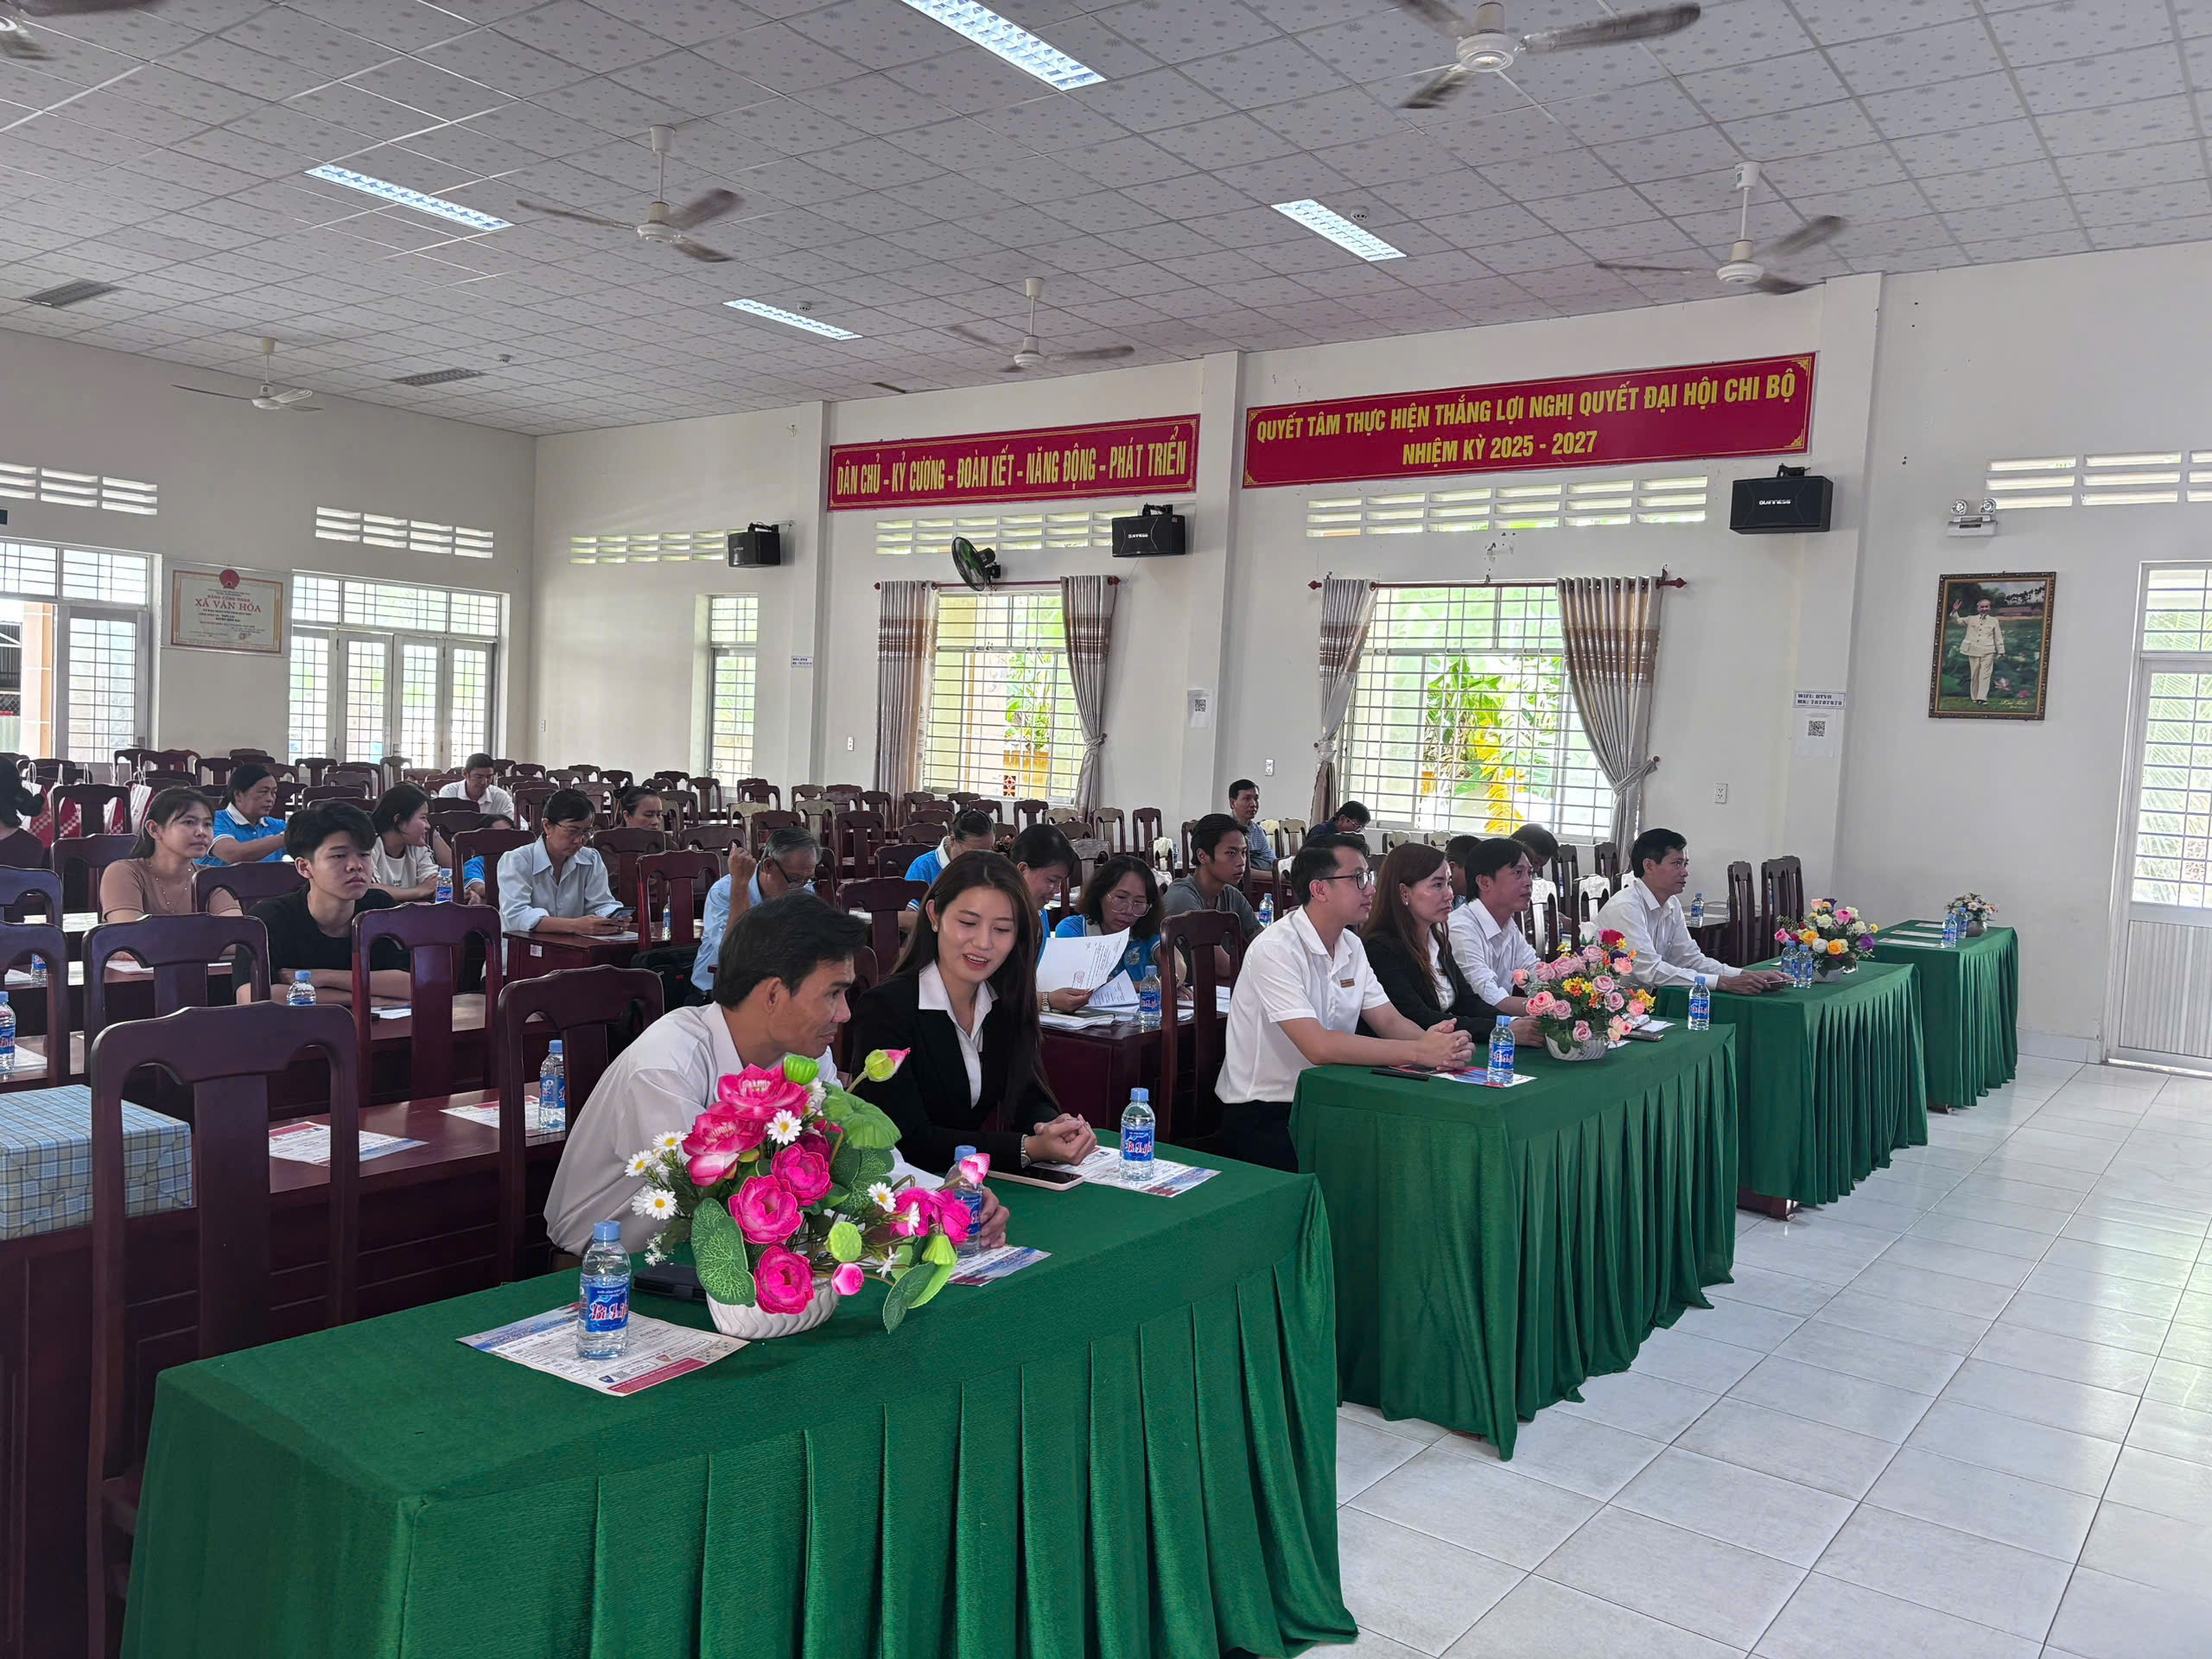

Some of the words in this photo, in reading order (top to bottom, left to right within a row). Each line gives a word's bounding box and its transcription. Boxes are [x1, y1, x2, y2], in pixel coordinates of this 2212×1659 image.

[1257, 411, 1303, 443] QUYẾT
[1308, 411, 1340, 436] TÂM
[1346, 409, 1386, 436] THỰC
[1390, 403, 1429, 433] HIỆN
[1435, 394, 1491, 426] THẮNG
[1497, 395, 1524, 425] LỢI
[1529, 393, 1574, 420] NGHỊ
[1580, 380, 1639, 416] QUYẾT
[1643, 384, 1678, 413] ĐẠI
[1683, 376, 1718, 410] HỘI
[1724, 376, 1760, 403] CHI
[1765, 367, 1796, 403] BỘ
[836, 459, 858, 495] DÂN
[861, 452, 880, 494] CHỦ
[892, 450, 906, 493] KỶ
[909, 455, 945, 492] CƯƠNG
[957, 448, 988, 489] ĐOÀN
[991, 444, 1014, 486] KẾT
[1026, 445, 1059, 485] NĂNG
[1063, 442, 1096, 490] ĐỘNG
[1109, 436, 1143, 480] PHÁT
[1147, 425, 1187, 477] TRIỂN
[1402, 436, 1459, 467] NHIỆM
[1462, 433, 1486, 461] KỲ
[1490, 435, 1534, 459] 2025
[1551, 430, 1598, 455] 2027
[239, 601, 262, 613] HÓA
